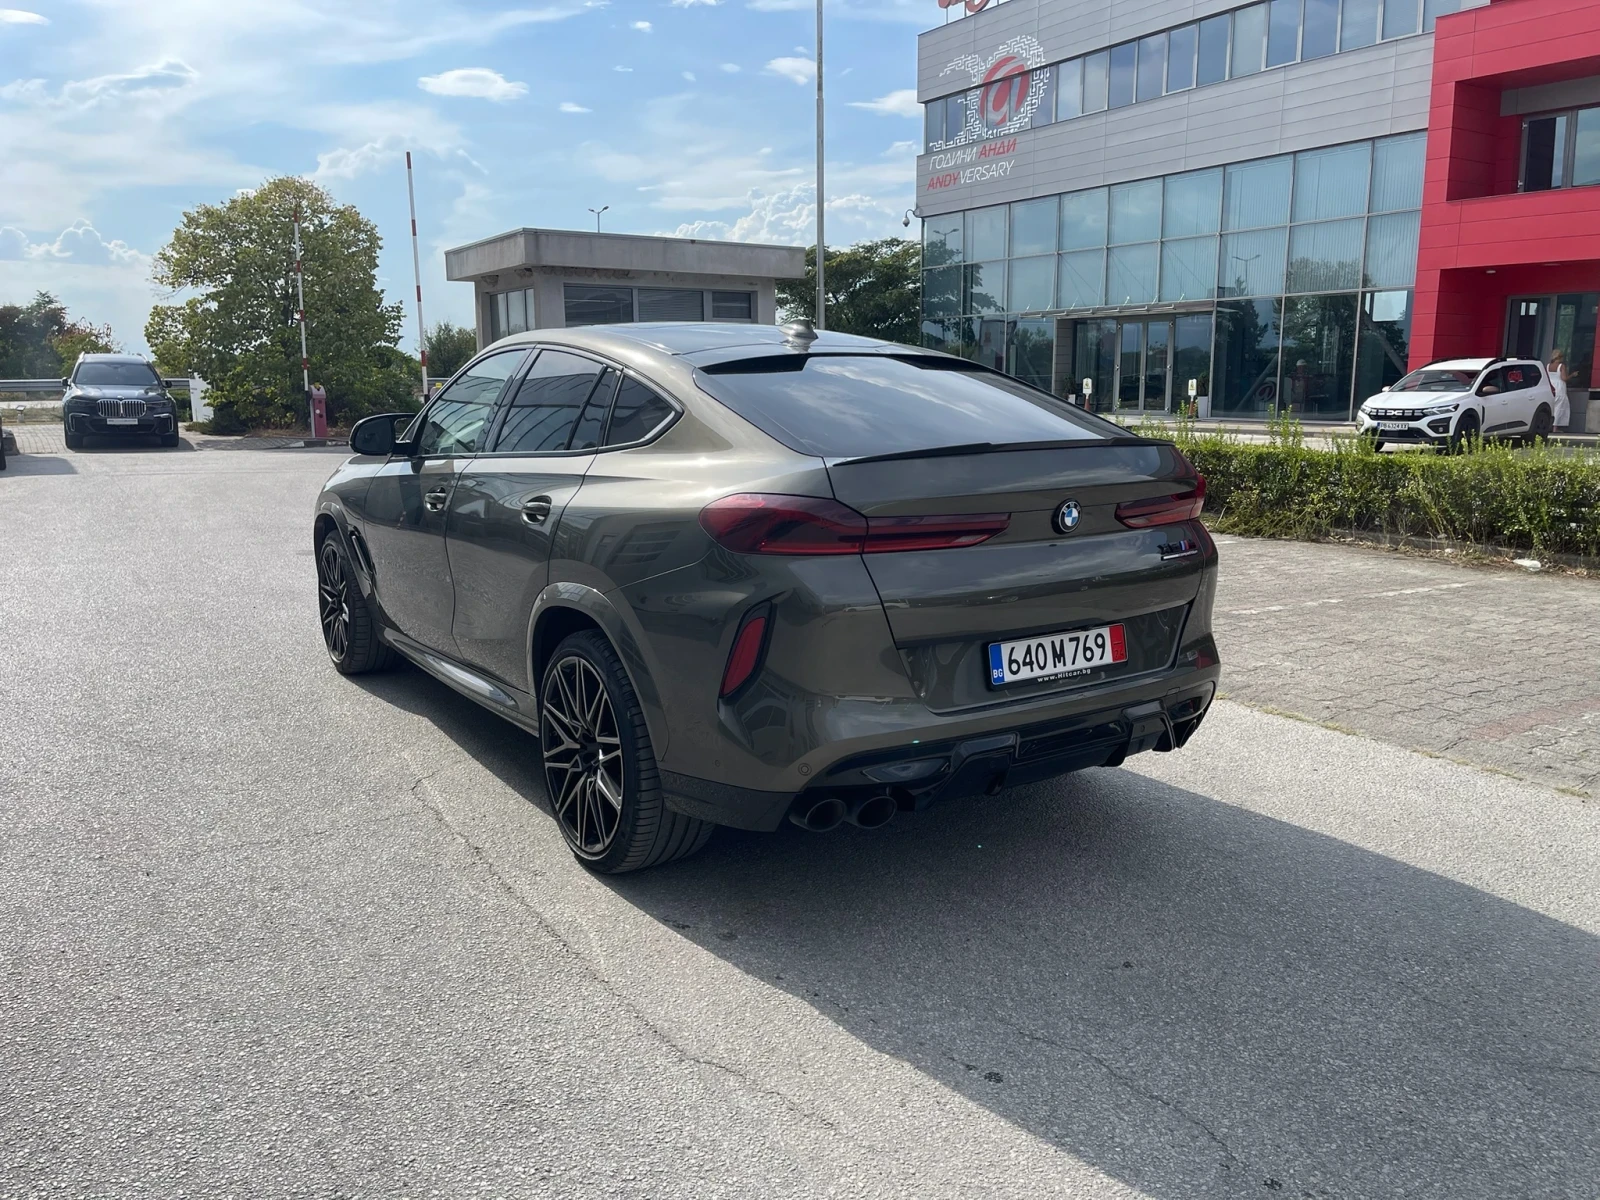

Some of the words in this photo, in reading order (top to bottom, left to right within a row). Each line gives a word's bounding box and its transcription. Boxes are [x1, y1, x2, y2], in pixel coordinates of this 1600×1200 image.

[928, 146, 977, 171] ГОДИНИ
[978, 138, 1018, 160] АНДИ
[1007, 632, 1106, 676] 640M769
[992, 668, 1003, 678] BG
[1037, 668, 1091, 683] www.Hitcar.bg
